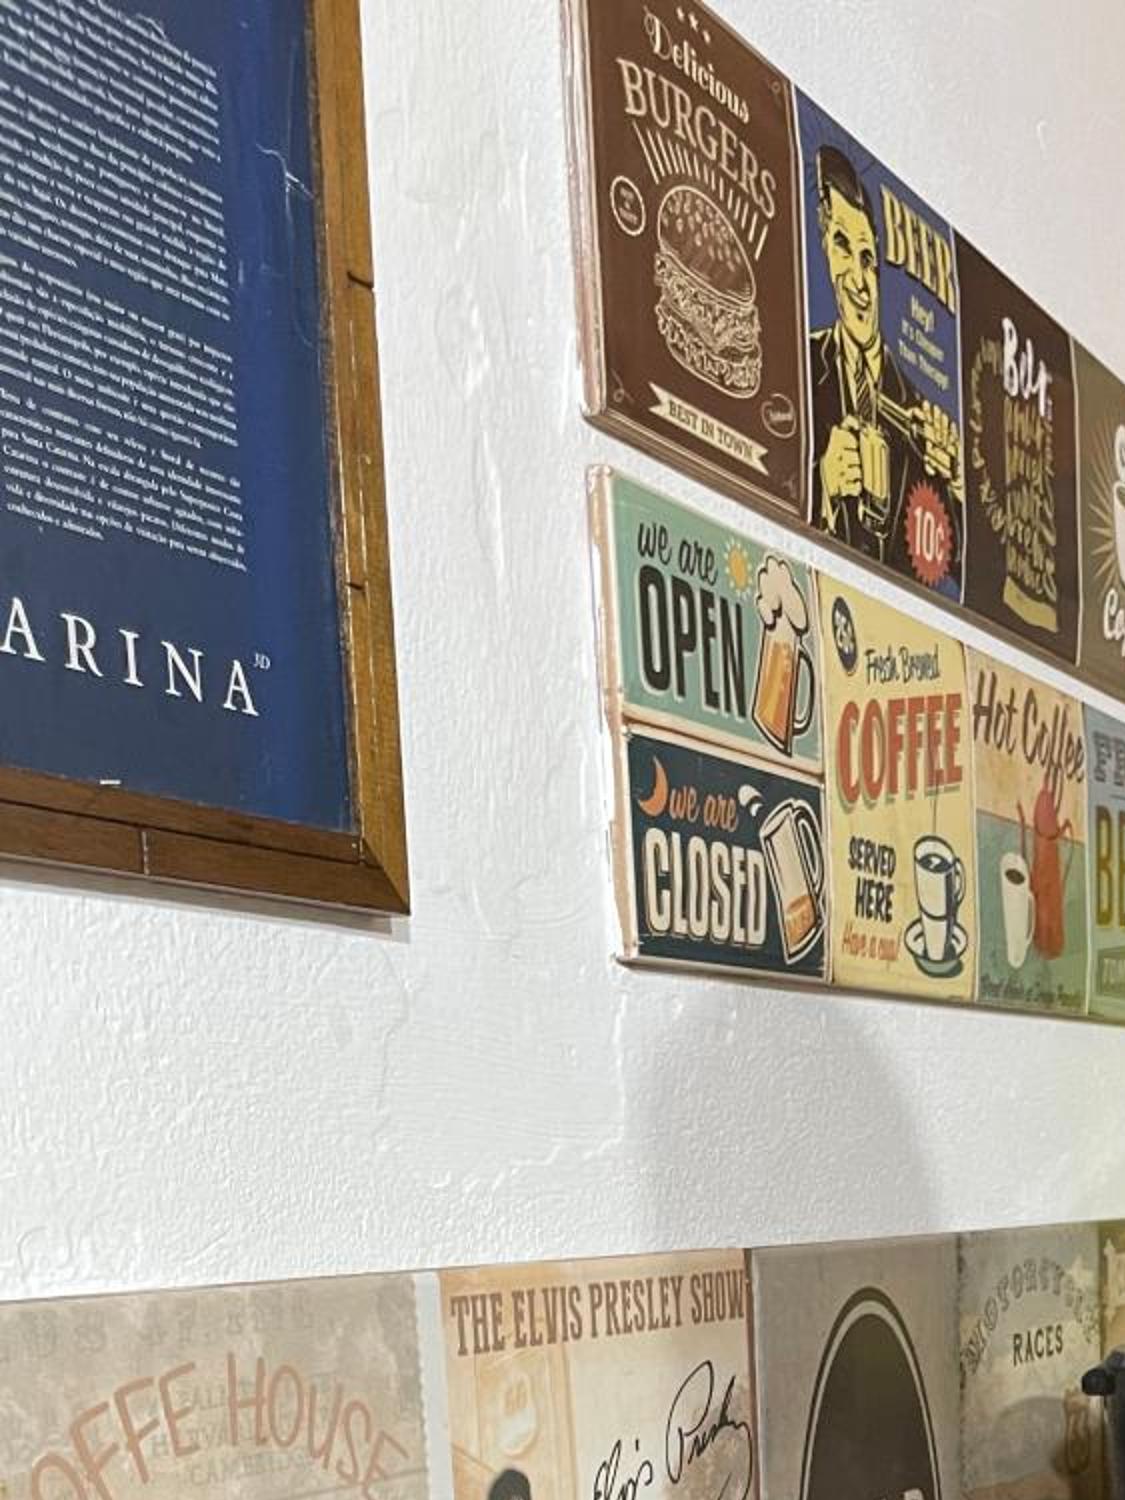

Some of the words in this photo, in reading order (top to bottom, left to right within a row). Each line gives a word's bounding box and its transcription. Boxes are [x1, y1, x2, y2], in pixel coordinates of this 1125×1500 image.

[644, 5, 749, 124] Delicious
[616, 57, 776, 218] BURGERS
[880, 183, 955, 316] BEER
[669, 400, 699, 431] BEST
[702, 417, 714, 438] IN
[718, 428, 754, 460] TOWN
[638, 521, 673, 566] we
[678, 541, 719, 588] are
[638, 565, 748, 720] OPEN
[837, 694, 963, 808] COFFEE
[973, 671, 1017, 755] Hot
[1021, 687, 1086, 805] Coffee
[643, 827, 767, 949] CLOSED
[848, 835, 896, 879] SERVED
[855, 876, 894, 923] HERE
[450, 1292, 506, 1357] THE
[511, 1286, 583, 1349] ELVIS
[588, 1275, 685, 1339] PRESLEY
[690, 1269, 746, 1325] SHOW
[1013, 1324, 1063, 1367] RACES
